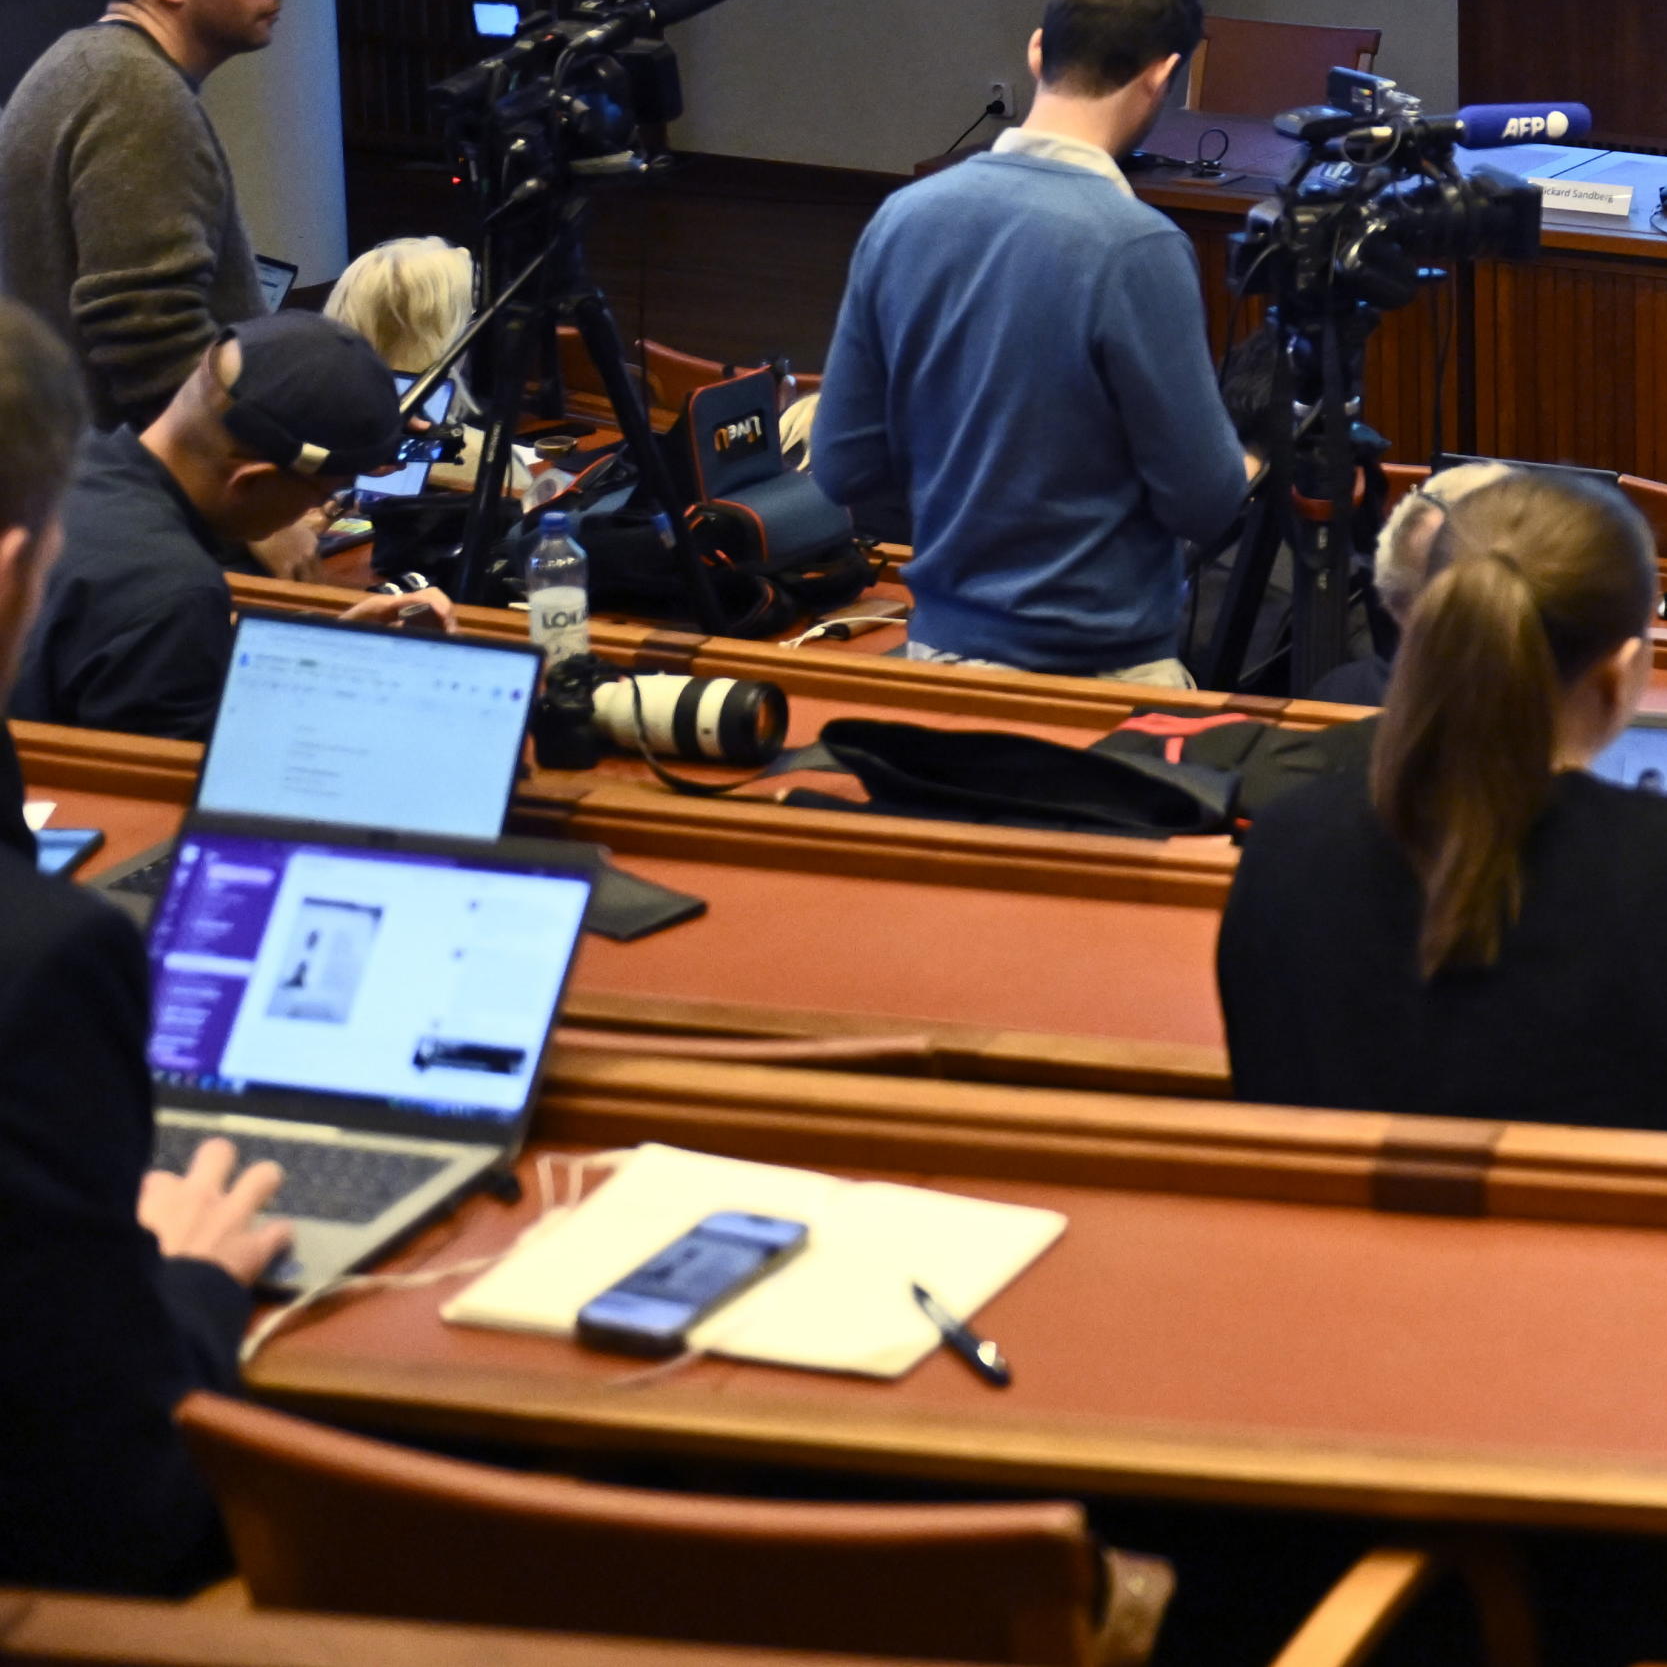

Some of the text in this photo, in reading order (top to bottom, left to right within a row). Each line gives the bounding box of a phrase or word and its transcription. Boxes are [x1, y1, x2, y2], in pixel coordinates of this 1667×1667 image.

[1501, 116, 1546, 139] AFP
[1541, 186, 1614, 204] ickard Sandberg
[714, 415, 762, 452] LiveU
